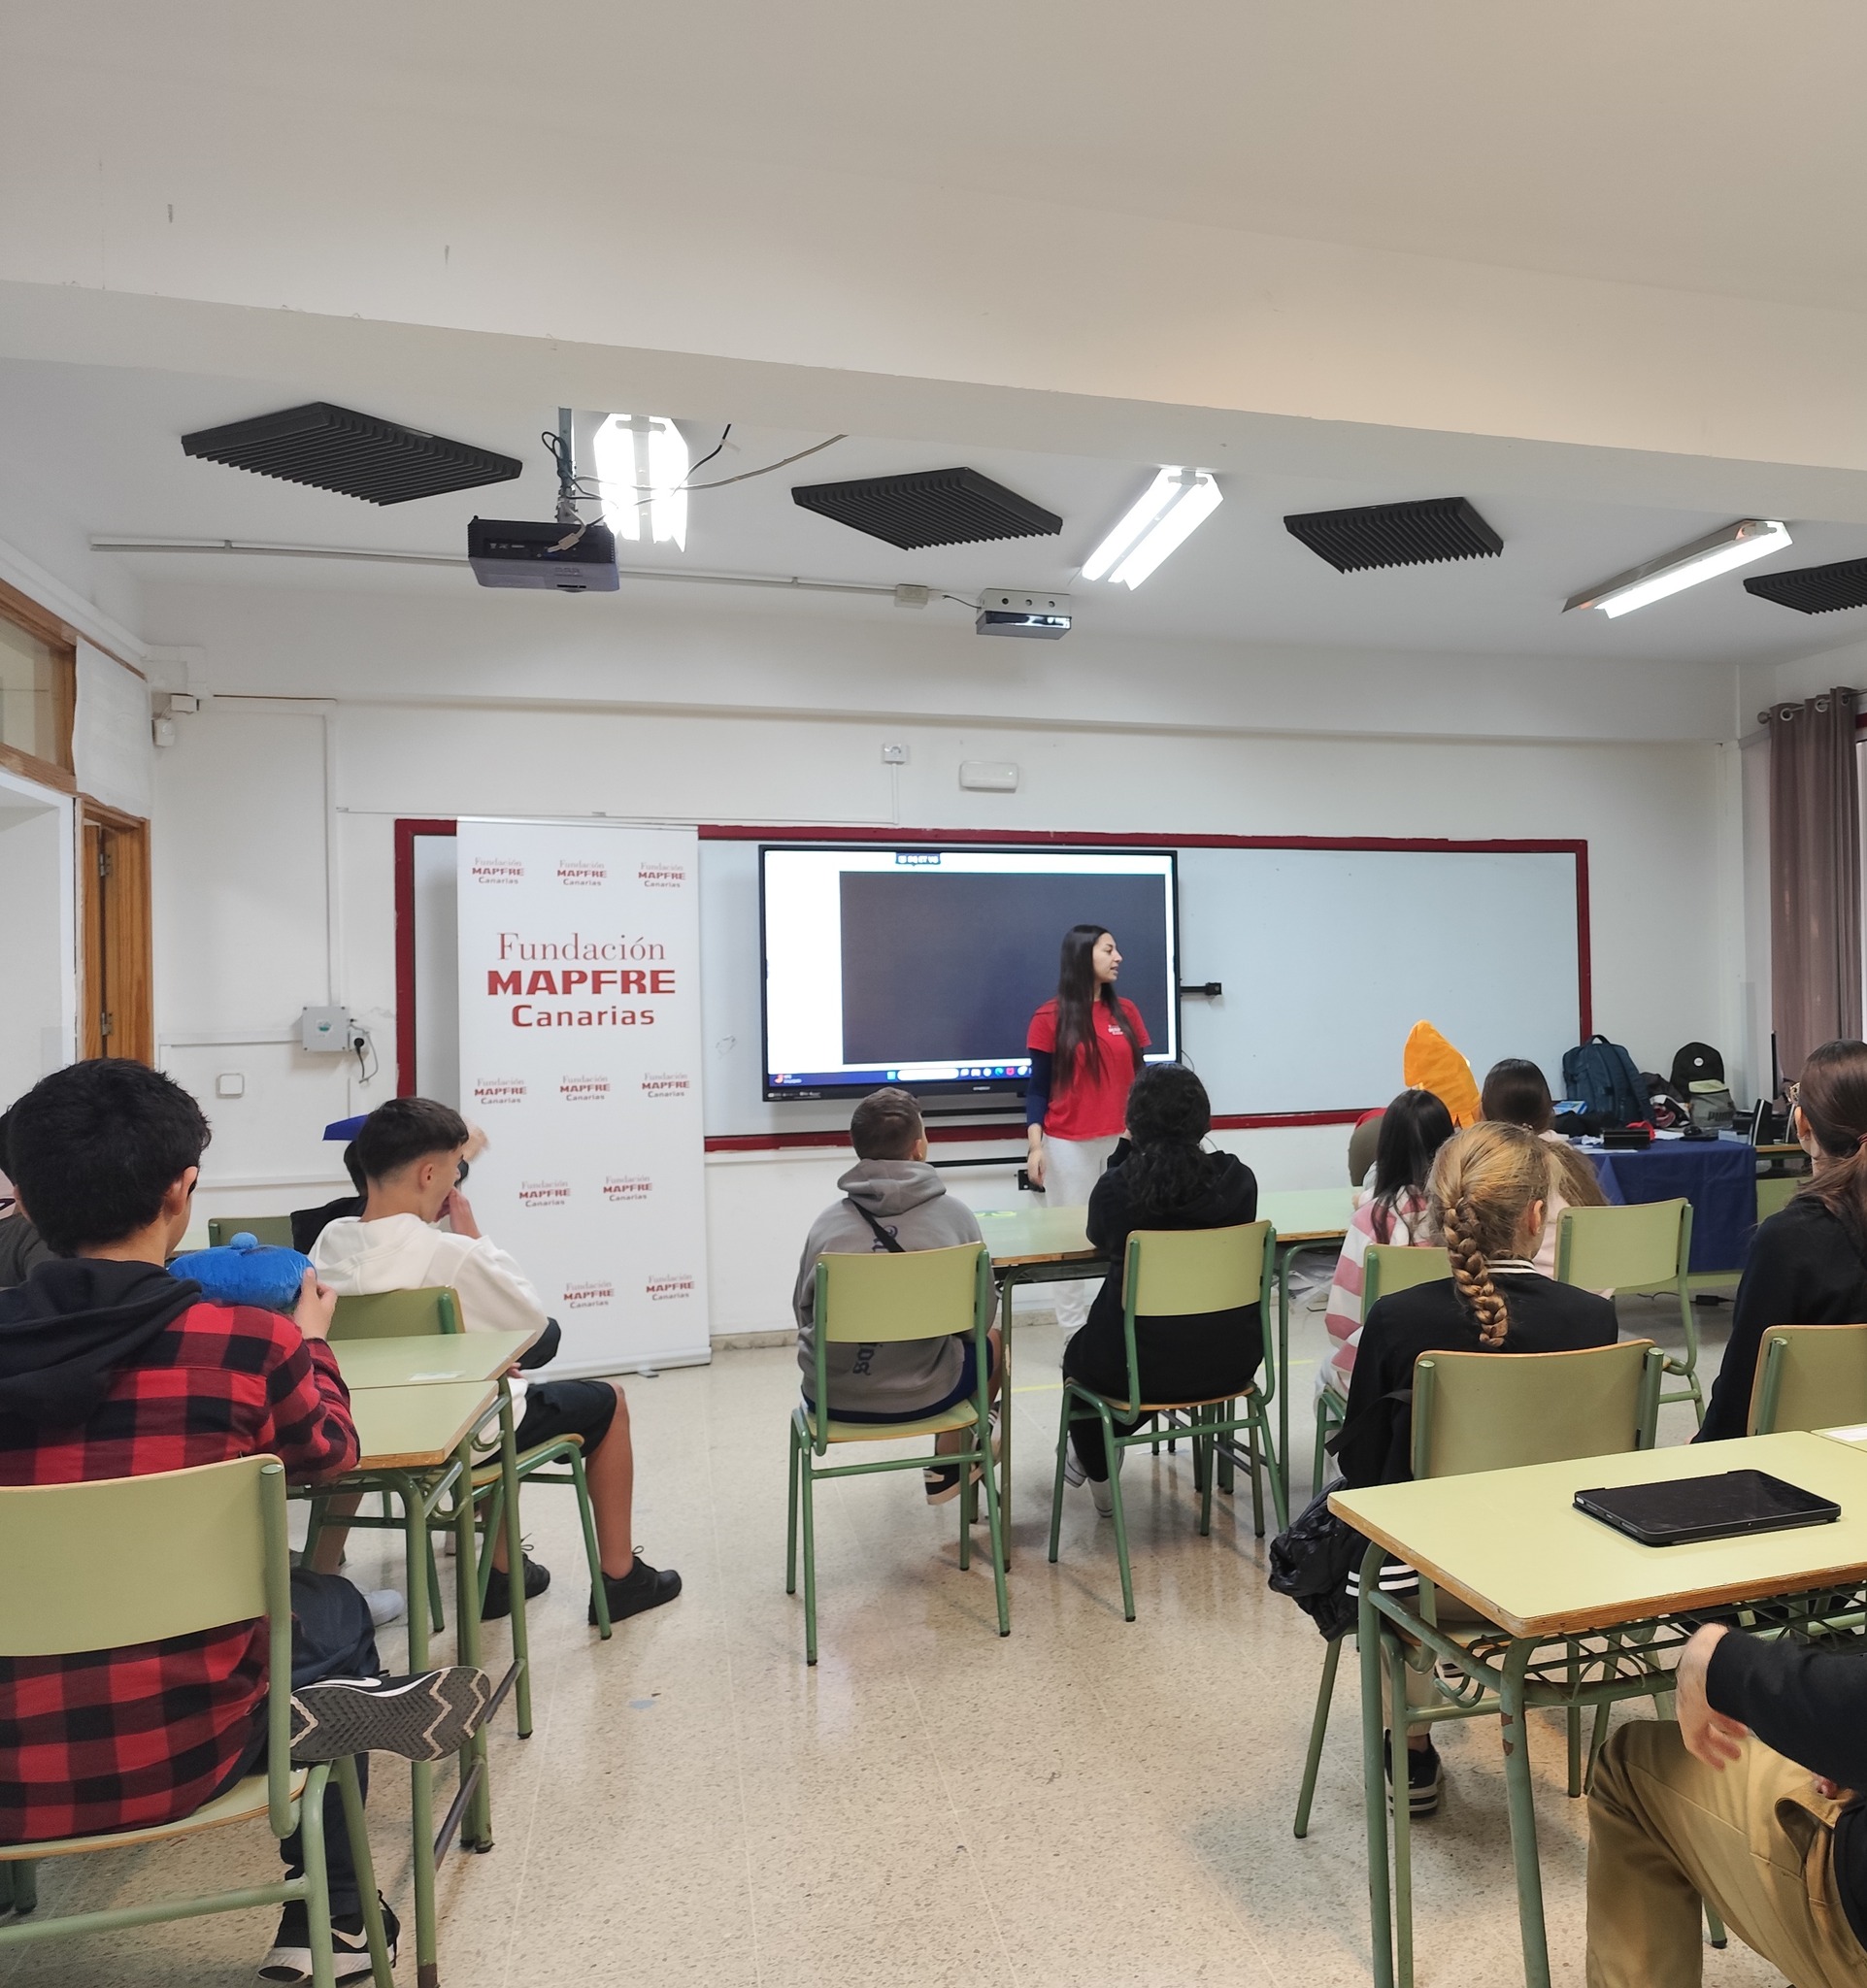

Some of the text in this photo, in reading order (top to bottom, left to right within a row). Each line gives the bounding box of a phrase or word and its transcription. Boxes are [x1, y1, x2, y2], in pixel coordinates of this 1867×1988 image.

[475, 857, 521, 866] Fundación
[559, 859, 605, 869] Fundación
[640, 862, 683, 871] Fundación
[472, 867, 524, 876] MAPFRE
[638, 872, 685, 880] MAPFRE
[497, 932, 666, 961] Fundación
[487, 970, 675, 995] MAPFRE
[512, 1005, 654, 1027] Canarias
[477, 1077, 524, 1086] Fundación
[562, 1076, 608, 1084] Fundación
[642, 1080, 689, 1090] MAPFRE
[475, 1086, 527, 1096] MAPFRE
[560, 1083, 611, 1093] MAPFRE
[521, 1179, 568, 1189] Fundación
[606, 1176, 650, 1184] Fundación
[519, 1188, 571, 1199] MAPFRE
[603, 1183, 652, 1194] MAPFRE
[525, 1199, 565, 1208] Canarias
[648, 1274, 692, 1283] Fundación
[566, 1280, 612, 1291] Fundación
[646, 1281, 695, 1293] MAPFRE
[564, 1288, 615, 1301] MAPFRE
[651, 1292, 689, 1301] Canarias
[570, 1300, 609, 1309] Canarias
